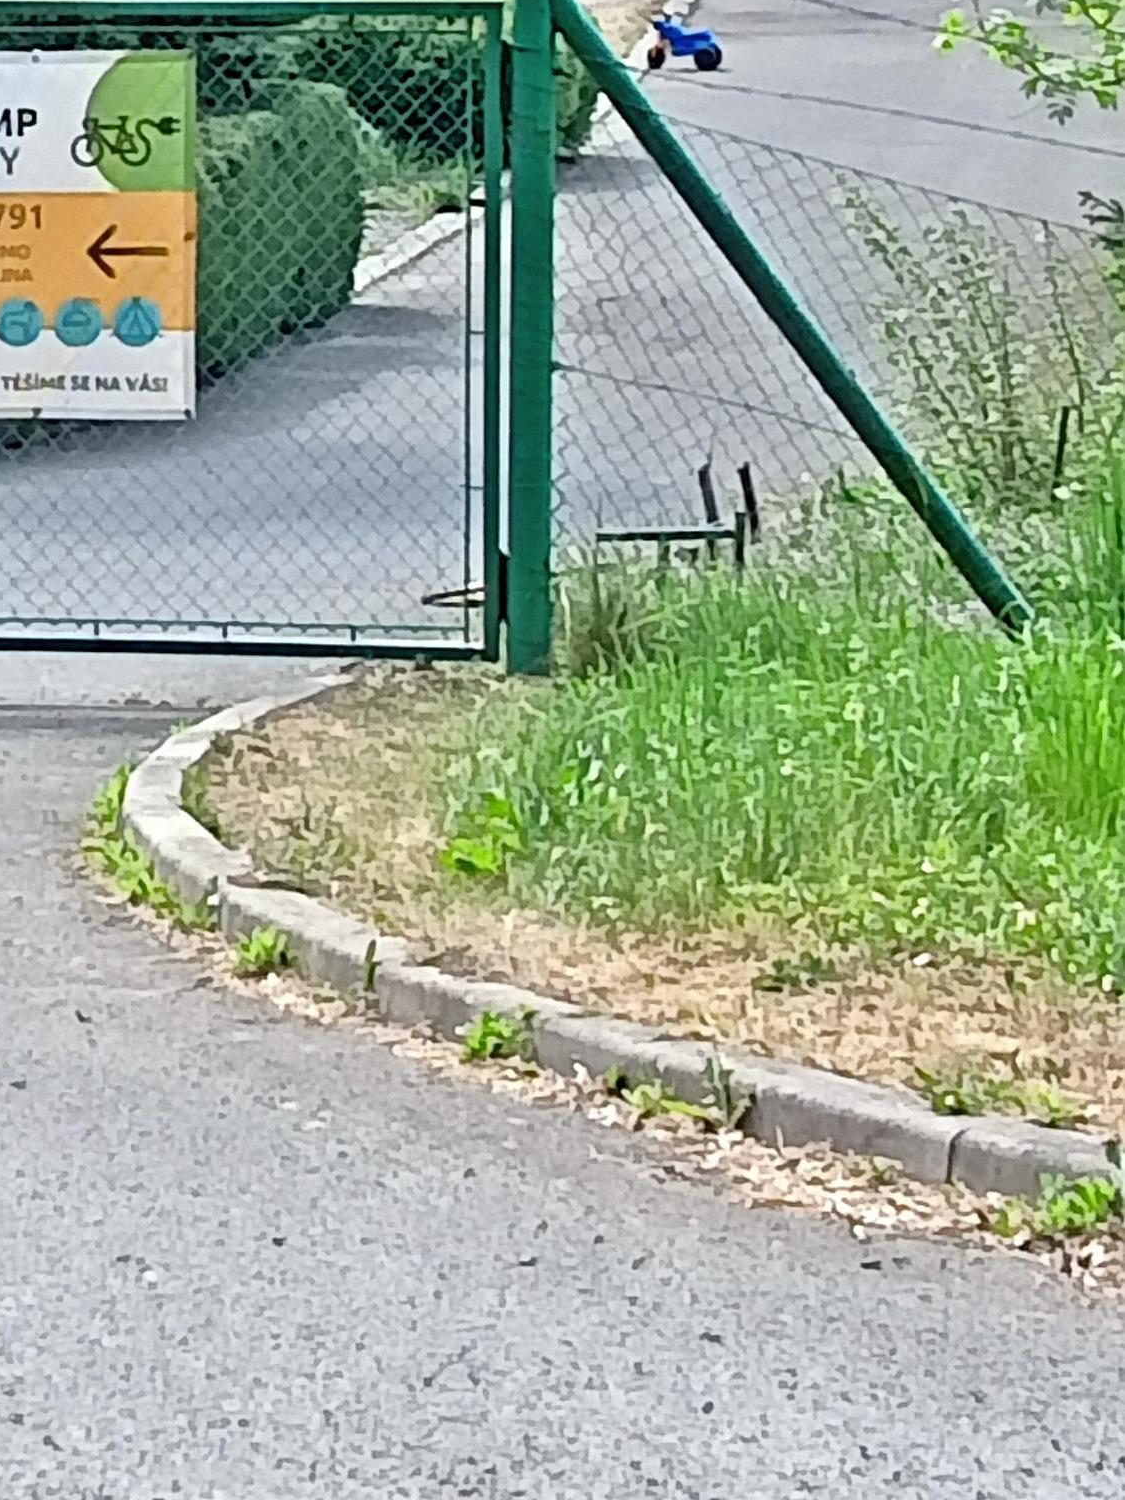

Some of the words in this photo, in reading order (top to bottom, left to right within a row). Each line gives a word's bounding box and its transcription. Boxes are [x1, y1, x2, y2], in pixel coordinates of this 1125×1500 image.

[1, 372, 67, 392] TĚŠÍME
[71, 375, 91, 392] SE
[95, 376, 122, 392] NA
